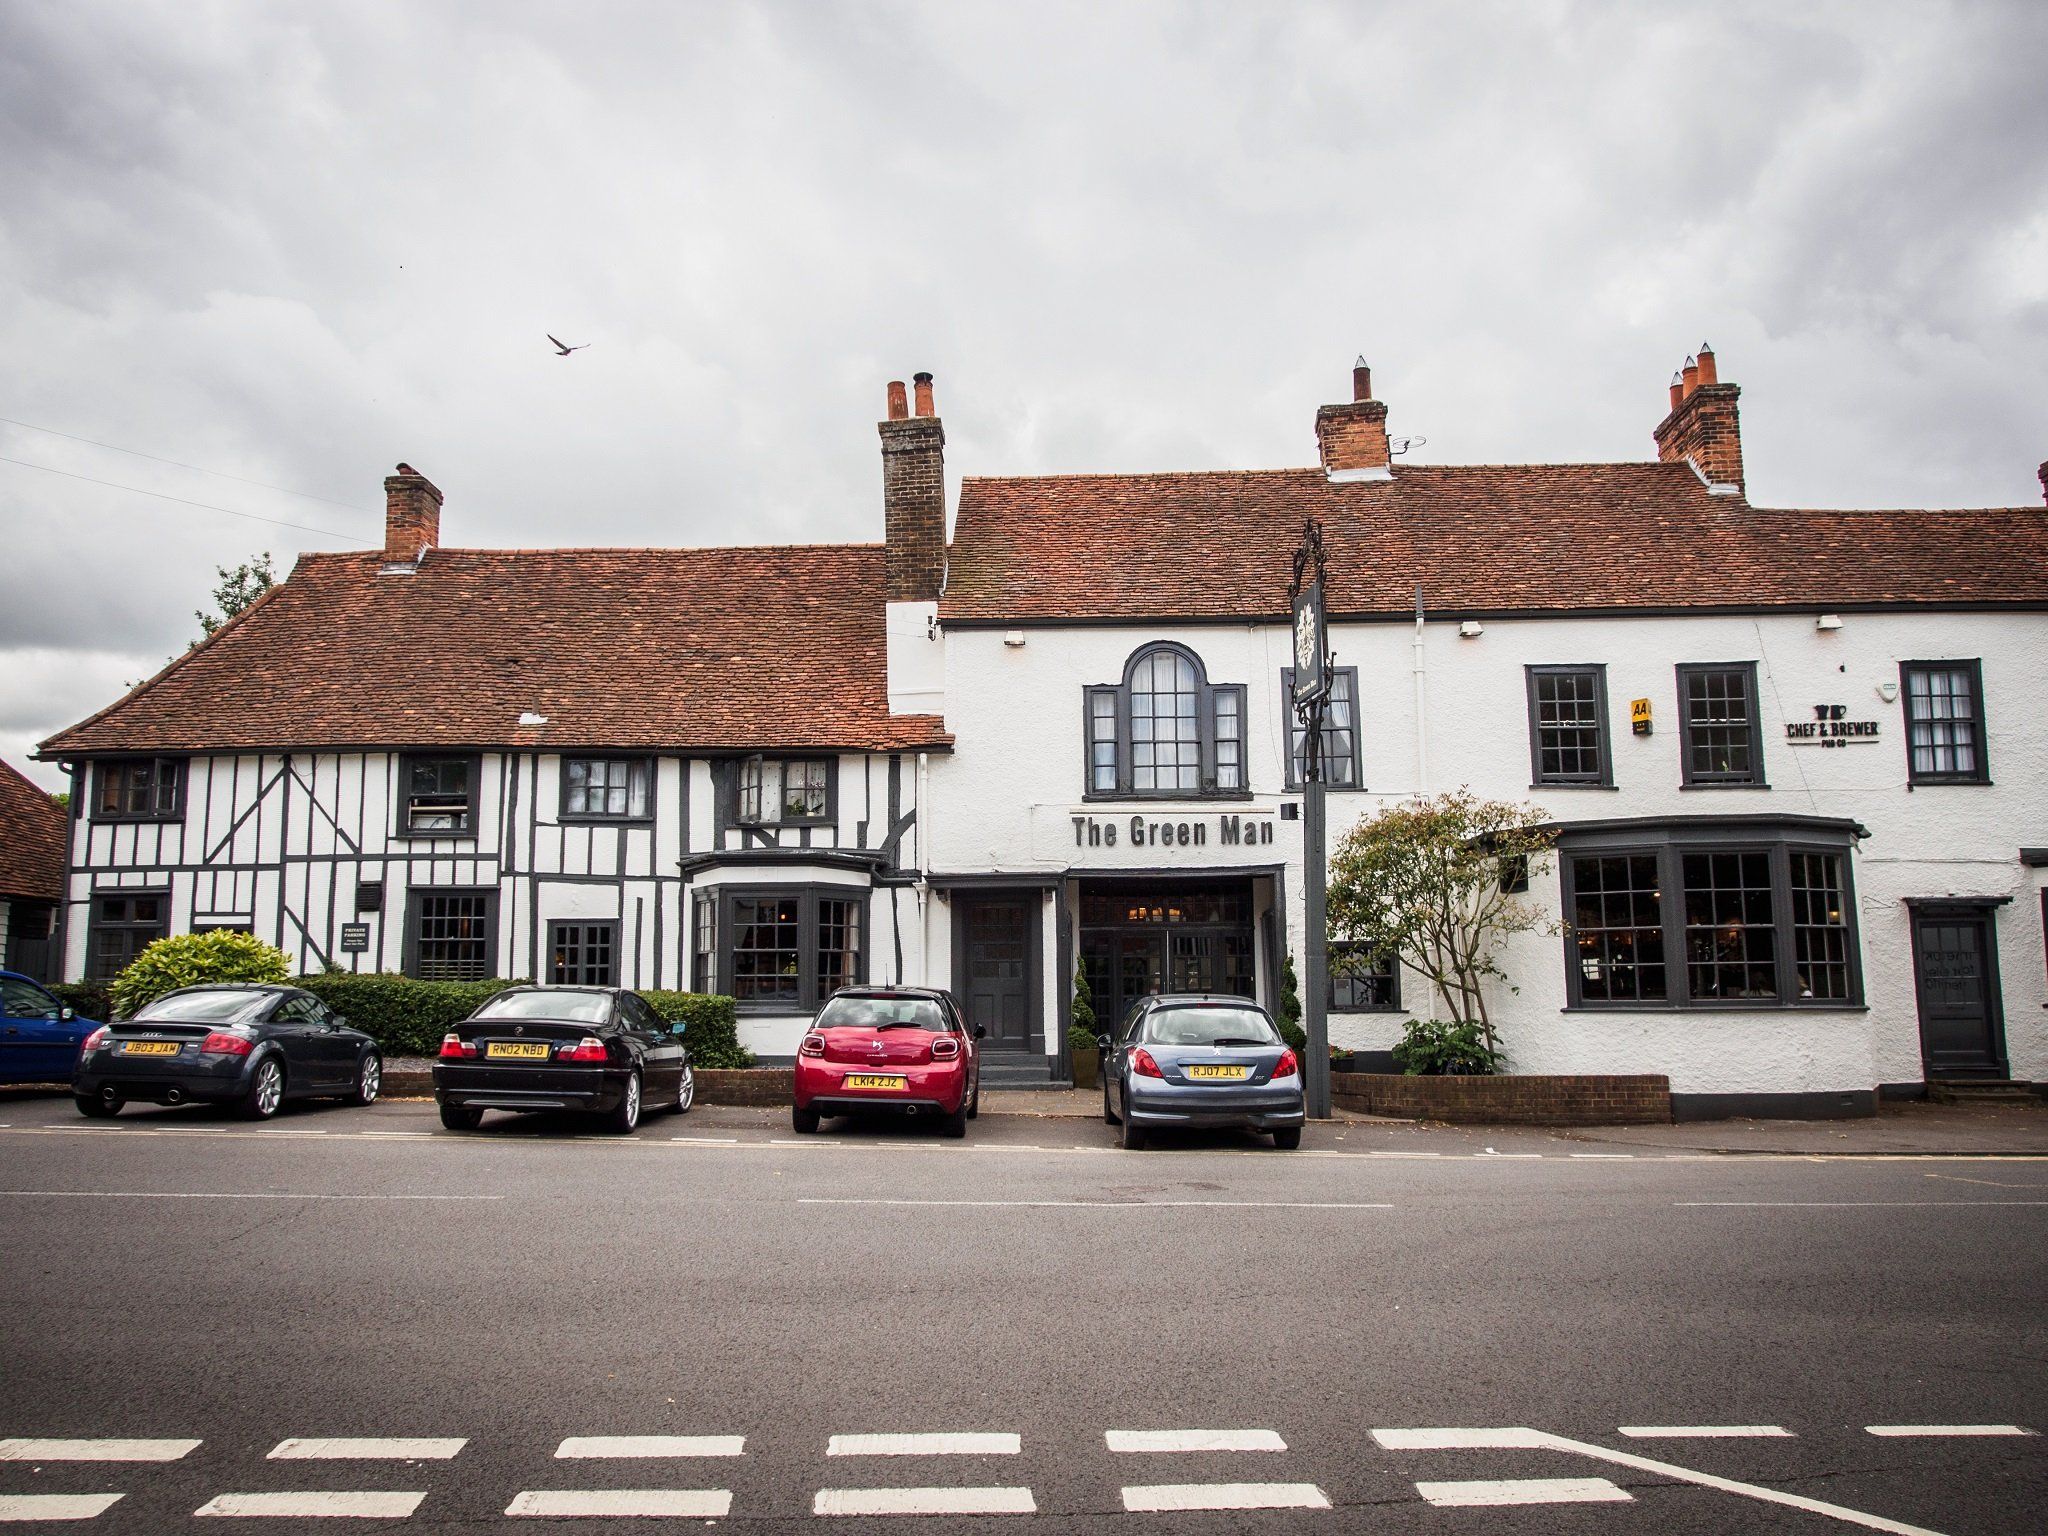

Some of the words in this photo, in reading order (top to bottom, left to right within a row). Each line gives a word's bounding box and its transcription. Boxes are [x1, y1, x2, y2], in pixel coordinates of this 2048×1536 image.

[1633, 702, 1647, 716] AA
[1787, 723, 1816, 738] CHEF
[1819, 722, 1828, 737] &
[1830, 721, 1879, 736] BREWER
[1821, 739, 1836, 748] PUB
[1071, 816, 1117, 847] The
[1130, 815, 1206, 846] Green
[1220, 815, 1273, 845] Man
[155, 1043, 176, 1054] JAM
[492, 1044, 521, 1055] RN02
[1193, 1066, 1220, 1076] RJ07
[1222, 1067, 1242, 1077] JLX
[853, 1077, 876, 1087] LK14
[877, 1077, 897, 1087] ZJZ
